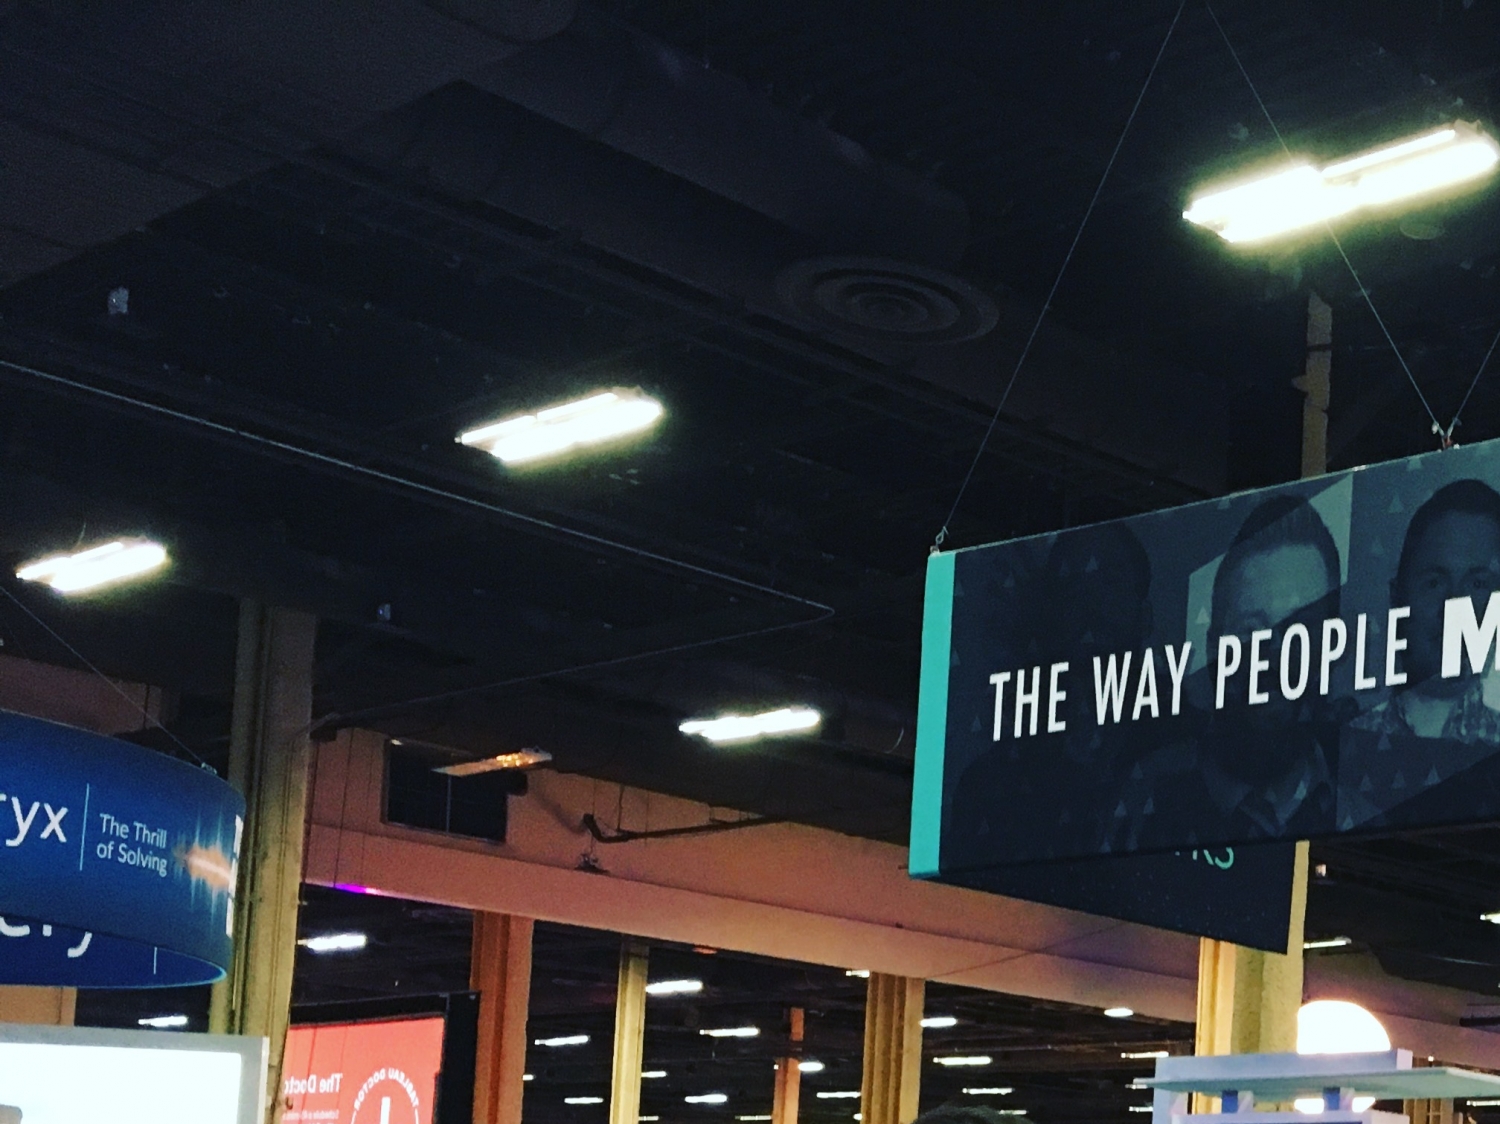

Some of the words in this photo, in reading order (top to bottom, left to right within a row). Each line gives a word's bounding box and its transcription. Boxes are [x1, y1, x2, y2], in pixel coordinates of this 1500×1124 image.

[989, 662, 1070, 741] THE
[1092, 641, 1192, 726] WAY
[1215, 606, 1411, 710] PEOPLE
[0, 794, 68, 847] yx
[99, 813, 130, 839] The
[133, 820, 167, 849] Thrill
[96, 841, 115, 859] of
[117, 843, 168, 878] Solving
